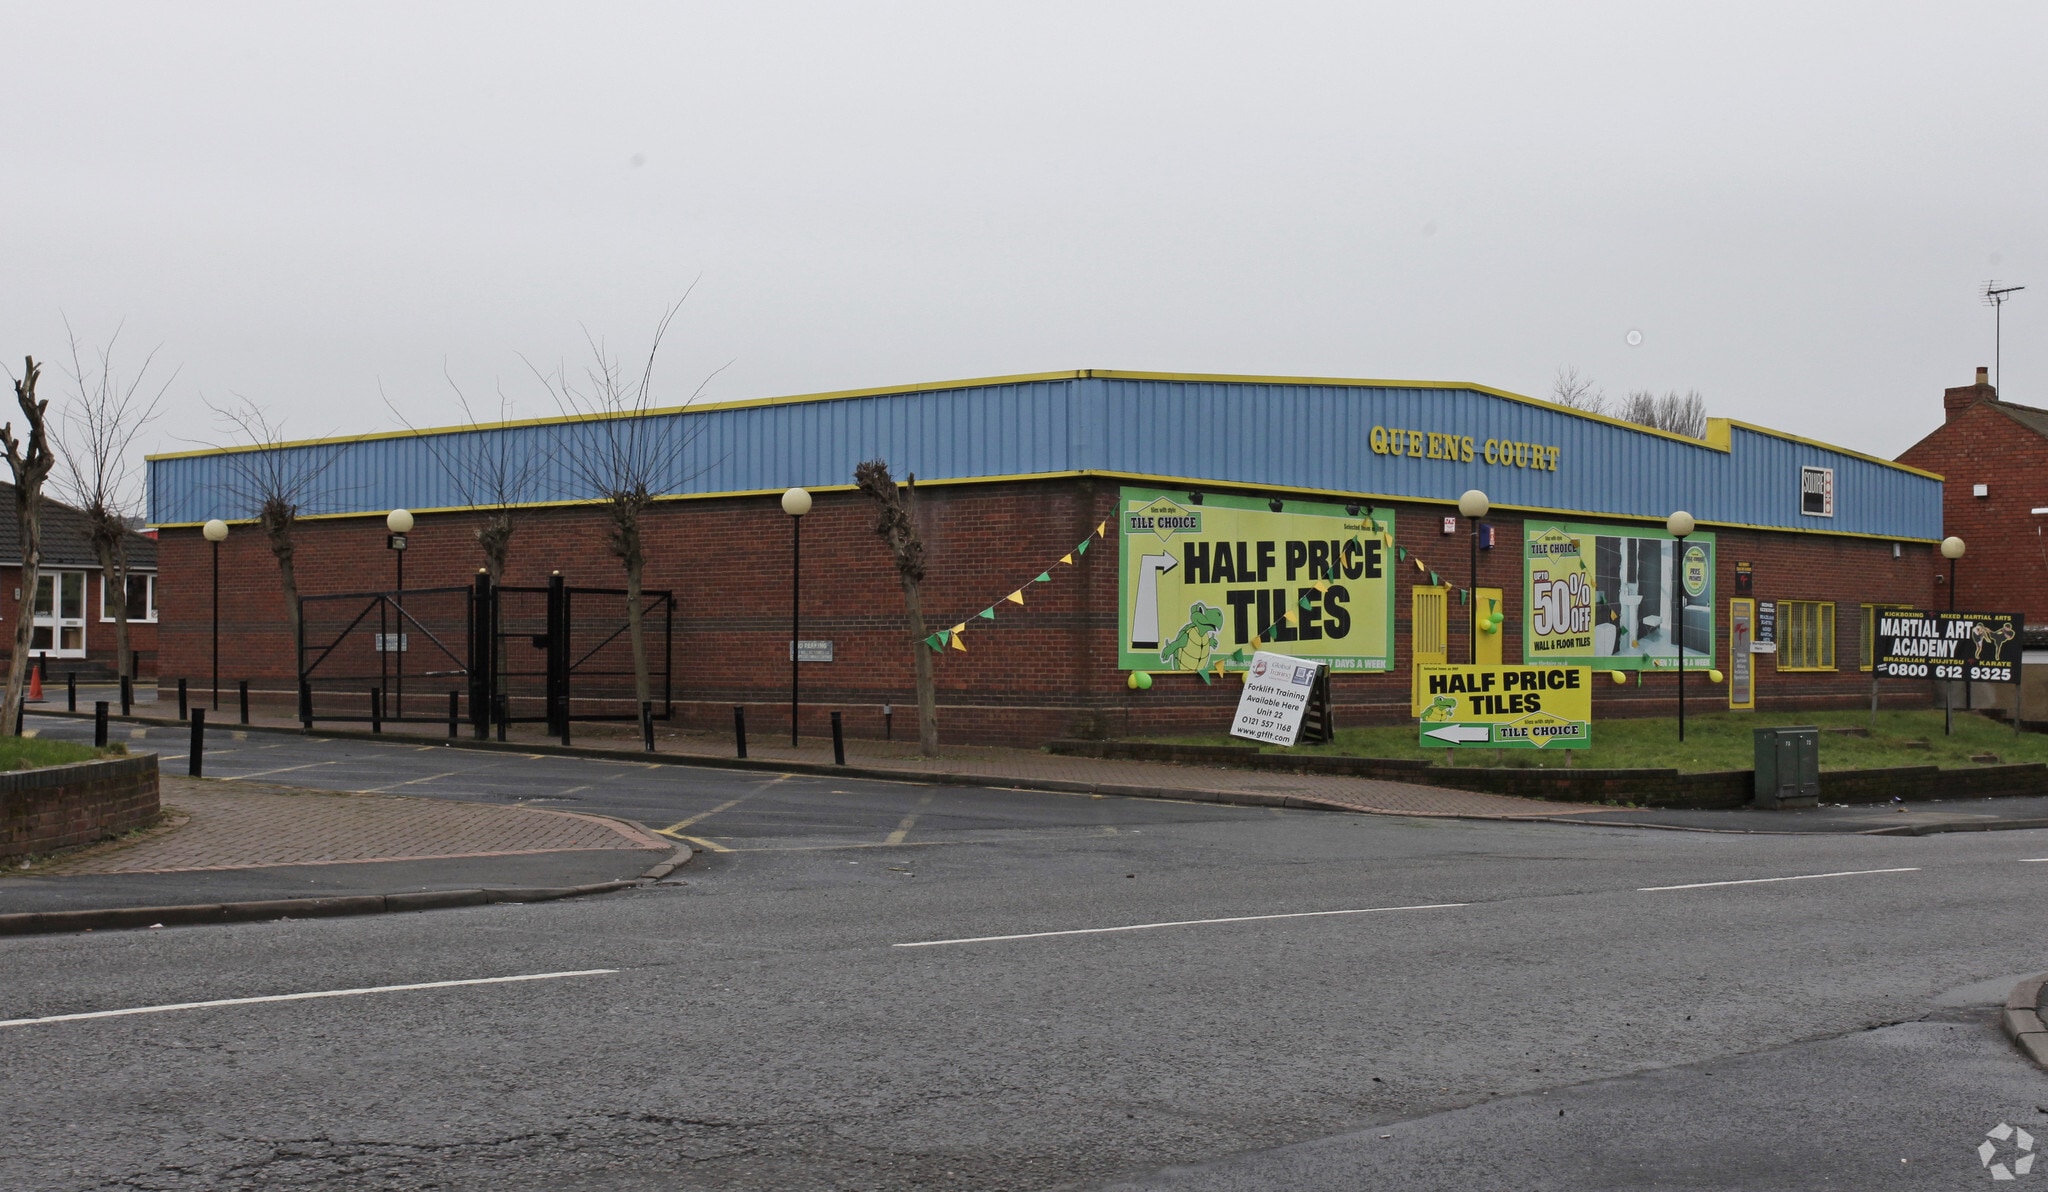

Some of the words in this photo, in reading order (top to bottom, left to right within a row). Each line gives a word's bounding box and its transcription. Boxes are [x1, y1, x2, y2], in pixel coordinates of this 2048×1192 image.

[1370, 425, 1474, 463] QUEENS
[1484, 438, 1560, 471] COURT
[1130, 517, 1154, 528] TILE
[1158, 517, 1197, 529] CHOICE
[1531, 544, 1547, 553] TILE
[1549, 544, 1577, 553] CHOICE
[1183, 540, 1276, 584] HALF
[1285, 539, 1382, 581] PRICE
[1226, 585, 1351, 645] TILES
[1571, 606, 1591, 633] OFF
[1880, 618, 1940, 638] MARTIAL
[1945, 620, 1973, 639] ART
[1534, 641, 1550, 651] WALL
[1551, 640, 1555, 649] &
[1556, 638, 1574, 649] FLOOR
[1575, 637, 1590, 647] TILES
[1892, 638, 1958, 658] ACADEMY
[1335, 659, 1356, 669] DAYS
[1356, 660, 1363, 669] A
[1365, 660, 1386, 669] WEEK
[1888, 663, 1928, 677] 0800
[1935, 665, 1962, 678] 612
[1970, 667, 2011, 681] 9325
[1429, 673, 1496, 694] HALF
[1503, 670, 1580, 691] PRICE
[1247, 683, 1274, 694] Forklift
[1276, 688, 1305, 701] Training
[1247, 694, 1280, 708] Available
[1281, 703, 1299, 711] Here
[1469, 693, 1541, 715] TILES
[1256, 708, 1272, 717] Unit
[1273, 711, 1283, 719] 22
[1242, 716, 1259, 725] 0121
[1261, 720, 1274, 729] 557
[1276, 723, 1292, 732] 1168
[1501, 728, 1528, 737] TILE
[1533, 726, 1579, 736] CHOICE
